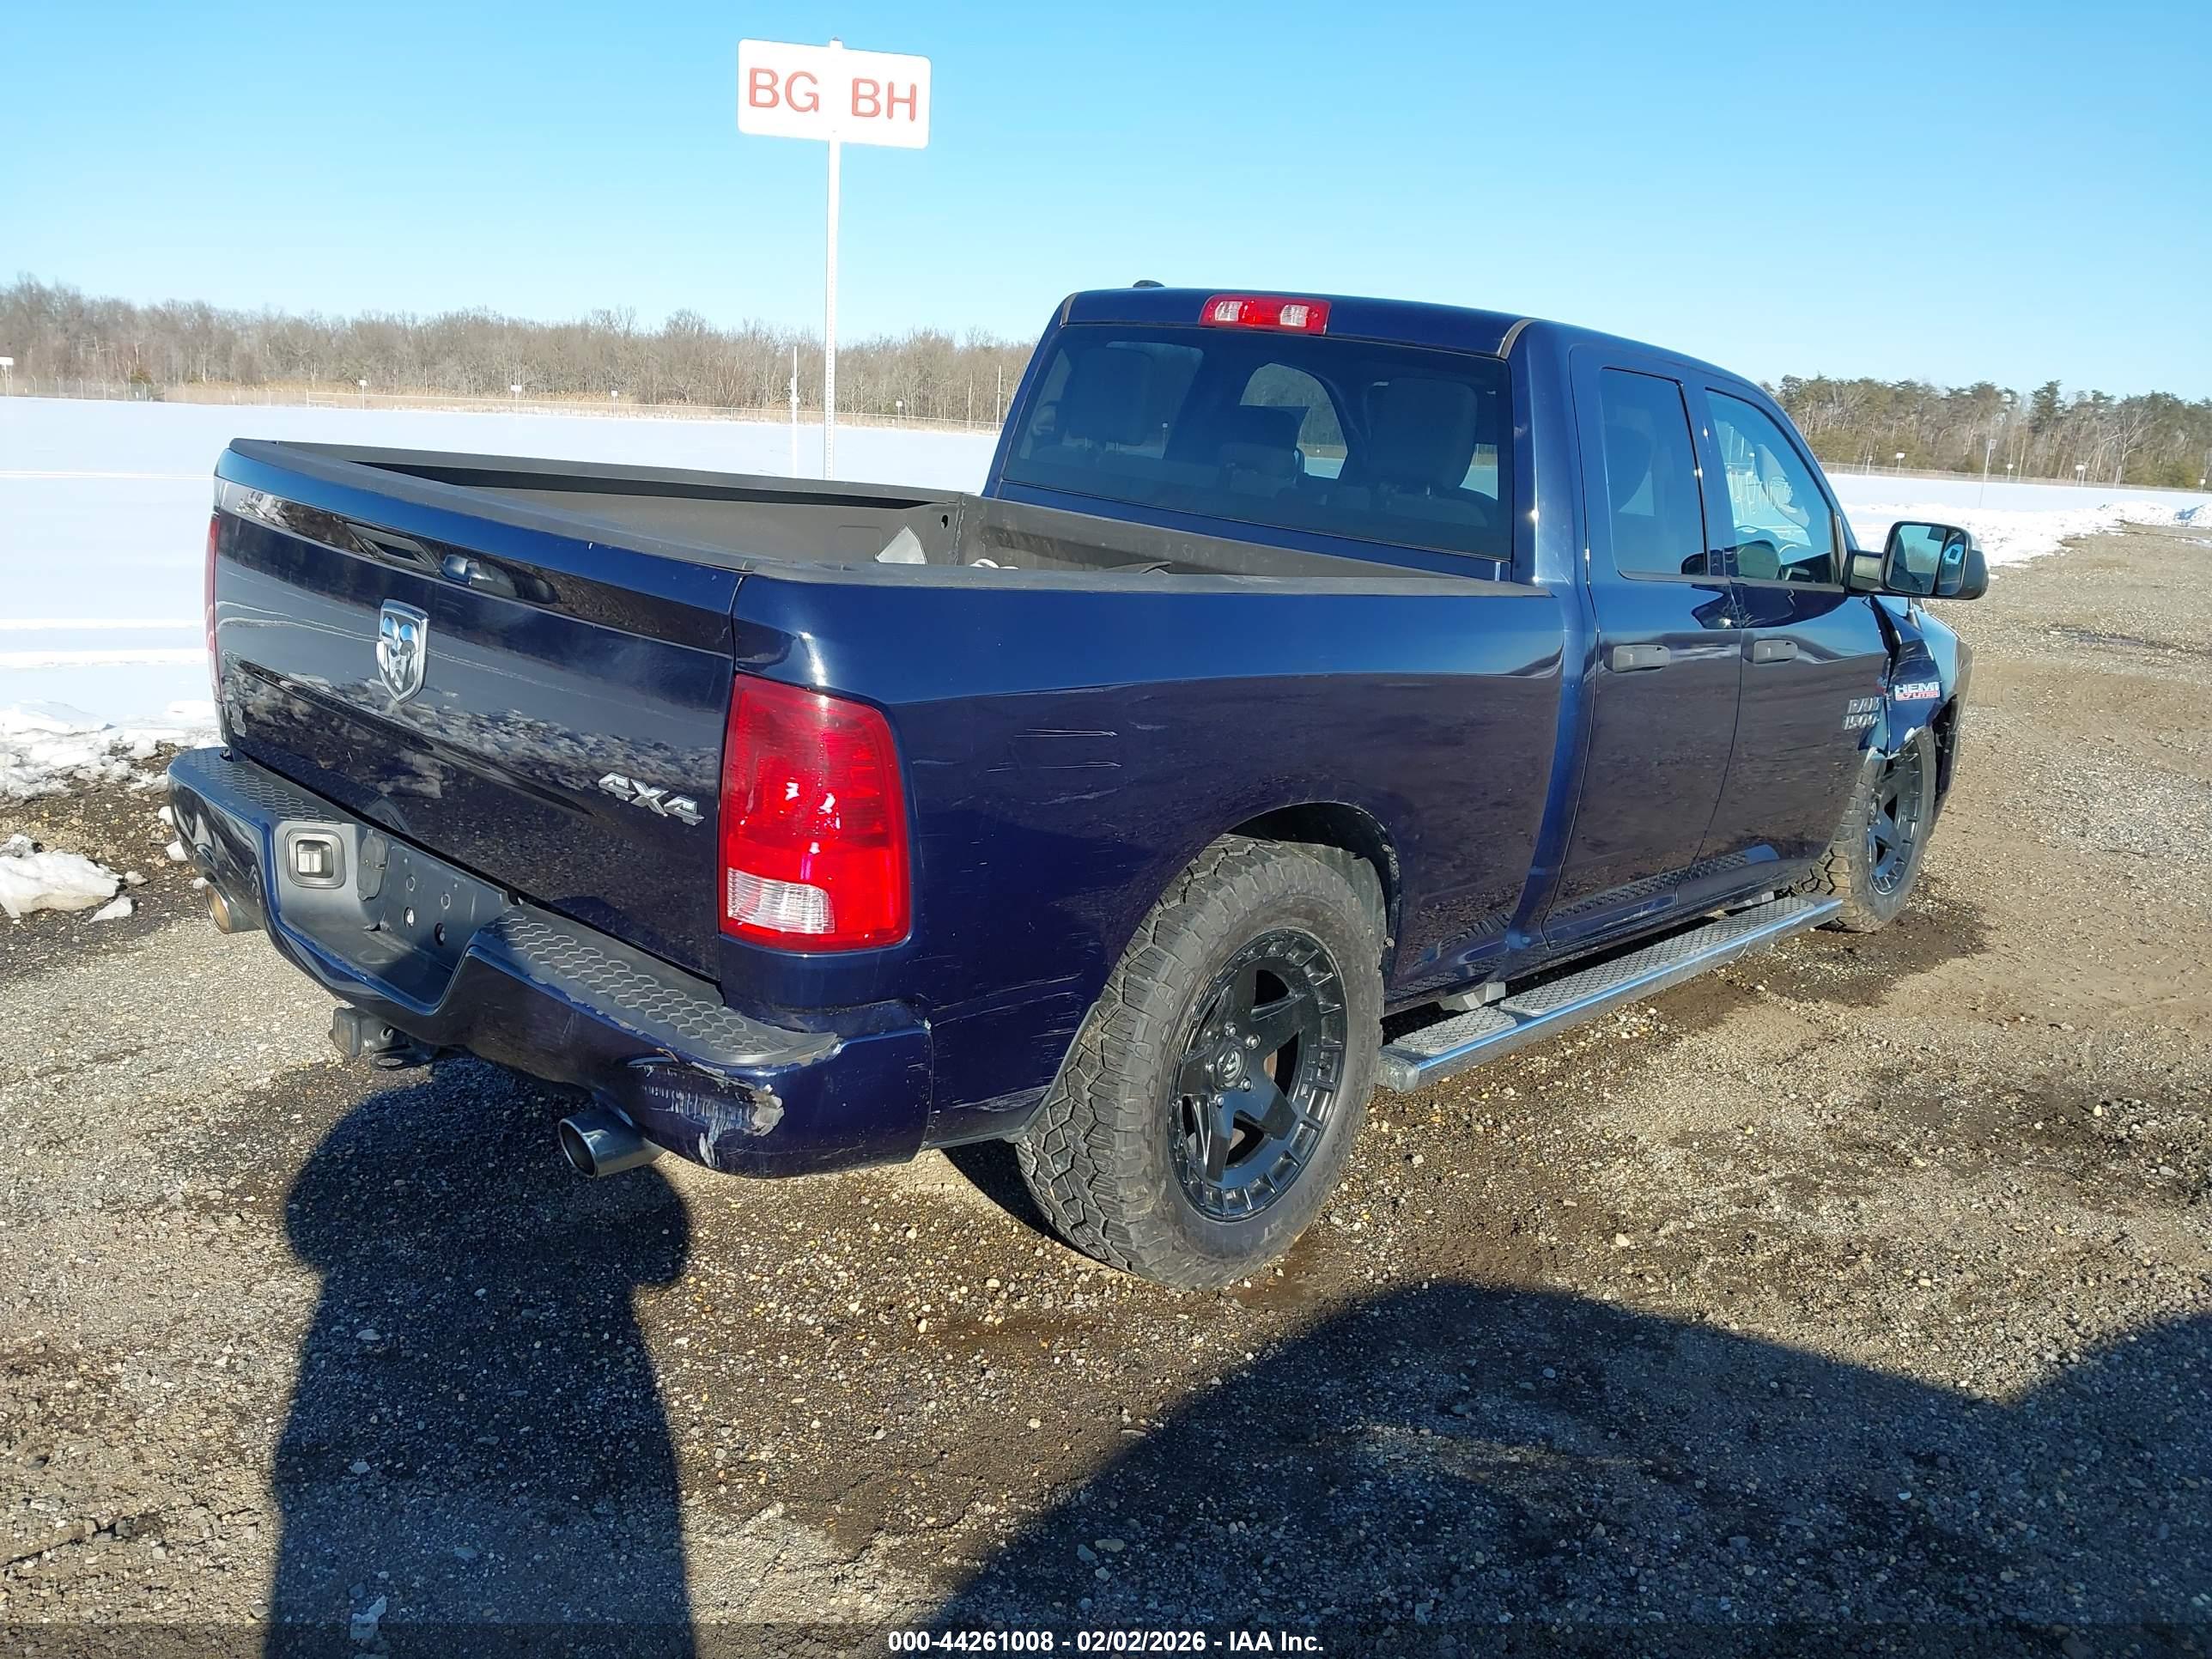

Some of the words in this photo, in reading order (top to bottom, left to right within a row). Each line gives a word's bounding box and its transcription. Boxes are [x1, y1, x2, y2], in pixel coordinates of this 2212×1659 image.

[749, 67, 819, 112] BG
[851, 77, 917, 122] BH
[1894, 682, 1940, 694] HEMI
